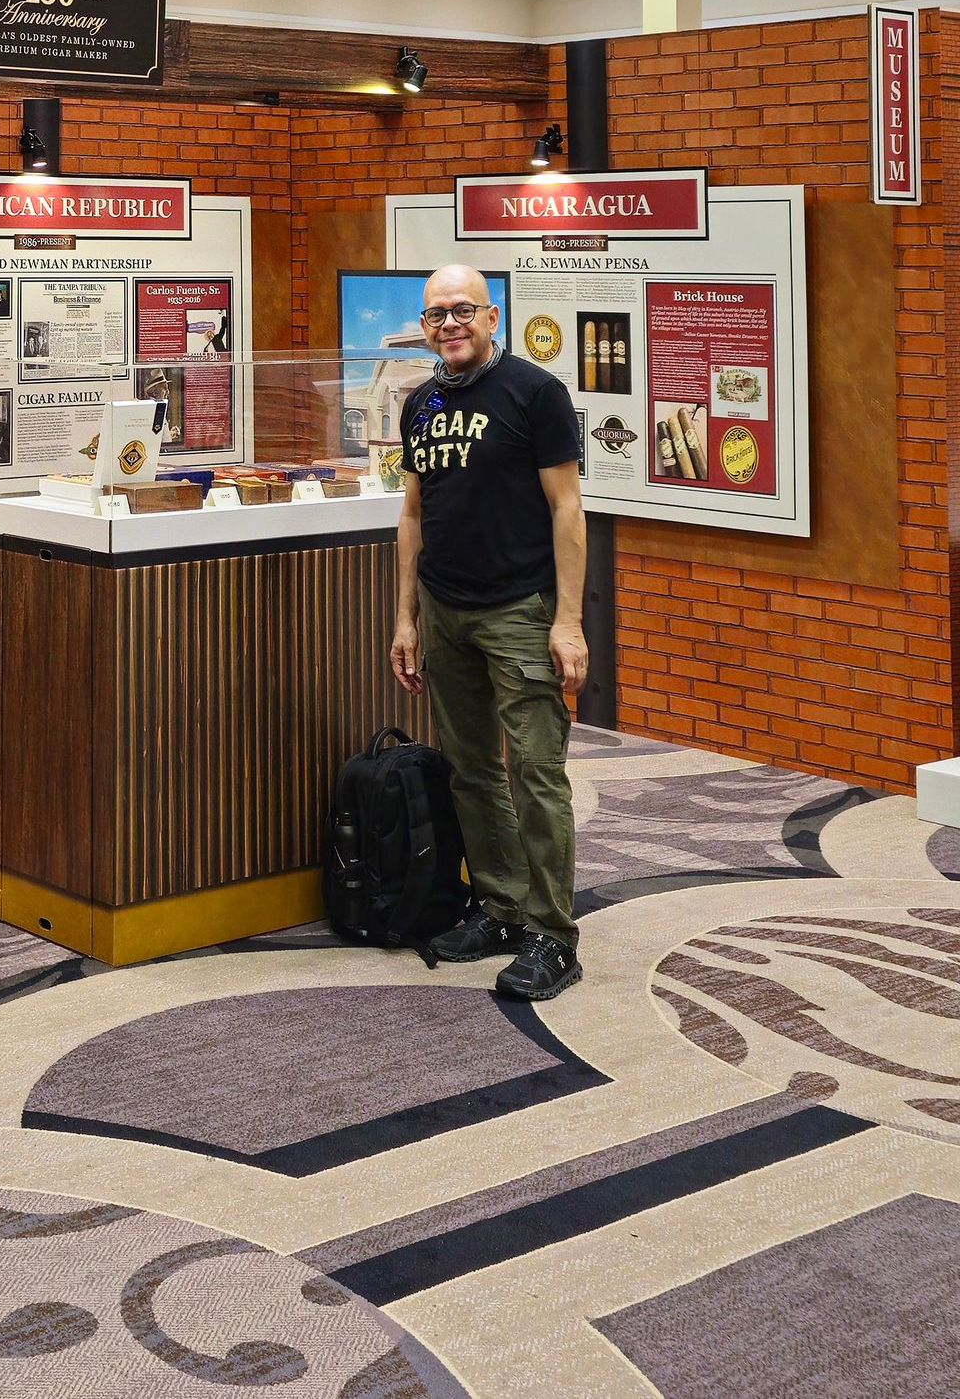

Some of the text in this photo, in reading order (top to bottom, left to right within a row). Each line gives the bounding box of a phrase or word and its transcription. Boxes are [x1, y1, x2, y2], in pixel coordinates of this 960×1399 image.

[20, 32, 58, 43] OLDEST
[61, 35, 136, 49] FAMILY-OWNED
[41, 47, 72, 58] CIGAR
[75, 50, 108, 60] MAKER
[887, 26, 906, 181] MUSEUM
[61, 197, 173, 220] REPUBLIC
[501, 194, 654, 218] NICARAGUA
[19, 237, 72, 248] 1986-PRESENT
[544, 238, 606, 250] 2003-PRESENT
[10, 258, 69, 270] NEWMAN
[71, 258, 153, 270] PARTNERSHIP
[515, 257, 650, 270] J.C. NEWMAN PENSA
[44, 283, 57, 291] THE
[58, 283, 79, 291] TAMPA
[146, 285, 221, 296] Carlos Fuente, Sr.
[167, 296, 201, 305] 1935-2016
[673, 290, 744, 302] Brick House
[535, 335, 552, 343] PDM
[17, 391, 103, 406] CIGAR FAMILY
[597, 430, 631, 440] QUORUM
[414, 442, 472, 473] CITY
